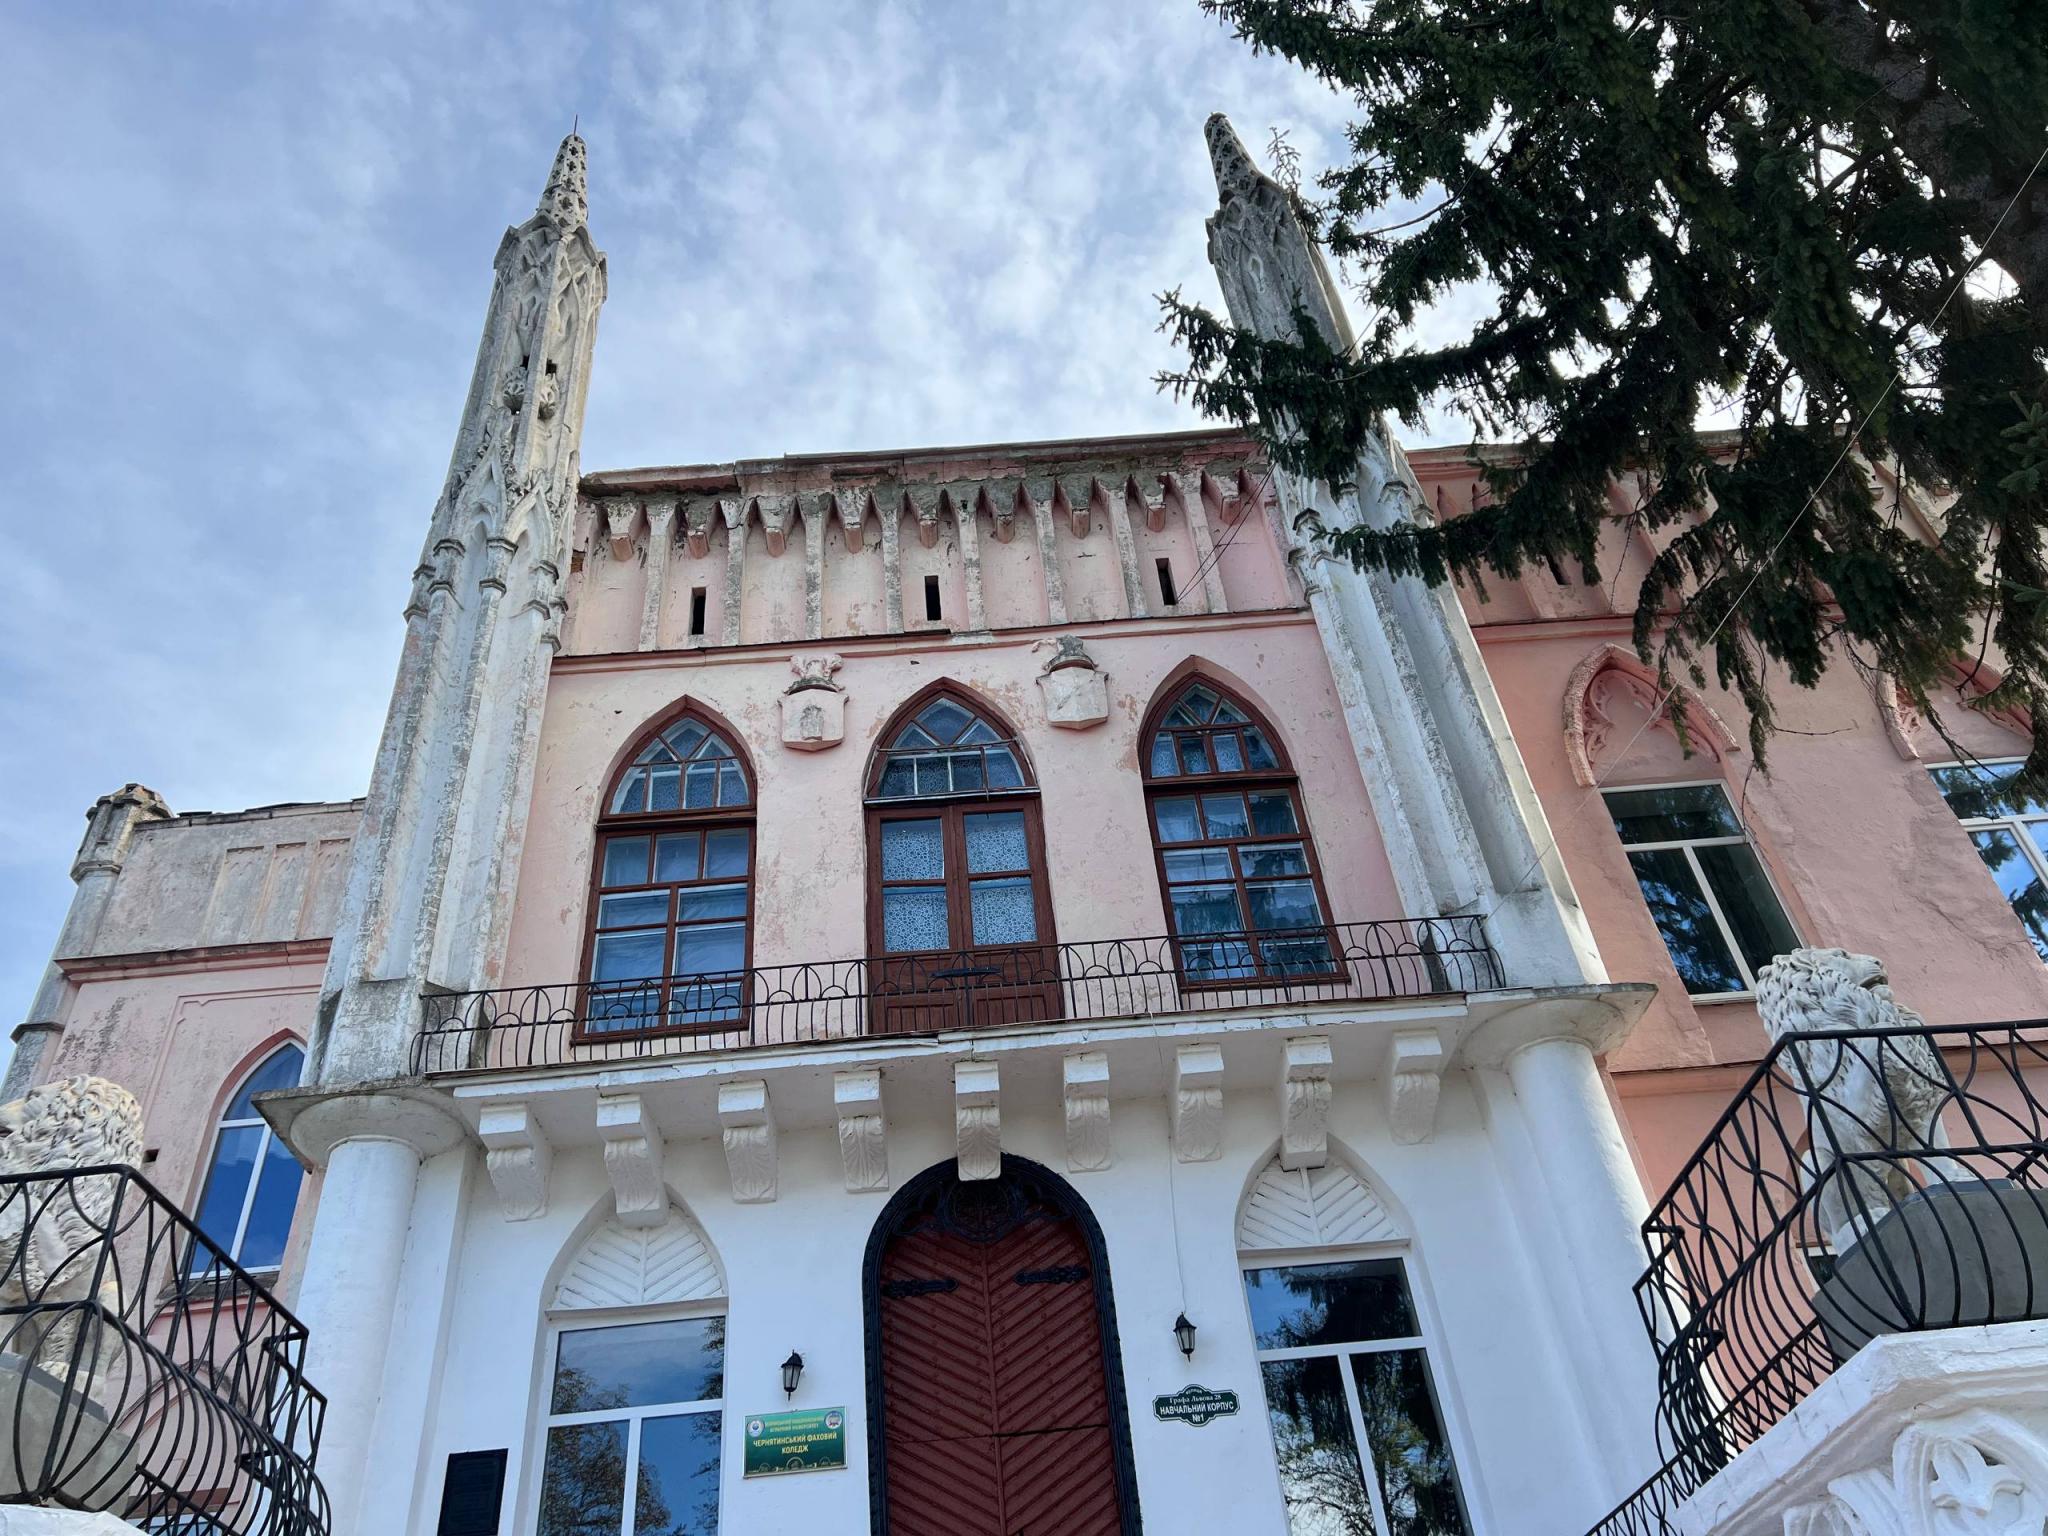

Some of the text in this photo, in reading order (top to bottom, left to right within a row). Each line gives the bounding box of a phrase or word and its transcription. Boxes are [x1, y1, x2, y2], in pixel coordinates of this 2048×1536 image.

[1169, 1396, 1190, 1405] Графа
[1159, 1401, 1234, 1415] НАВЧАЛЬНИЙ КОРПУС
[1192, 1413, 1204, 1422] №1
[753, 1431, 837, 1447] ЧЕРНЯТИНСЬКИЙ ФАХОВИЙ
[781, 1445, 809, 1454] КОЛЕДЖ
